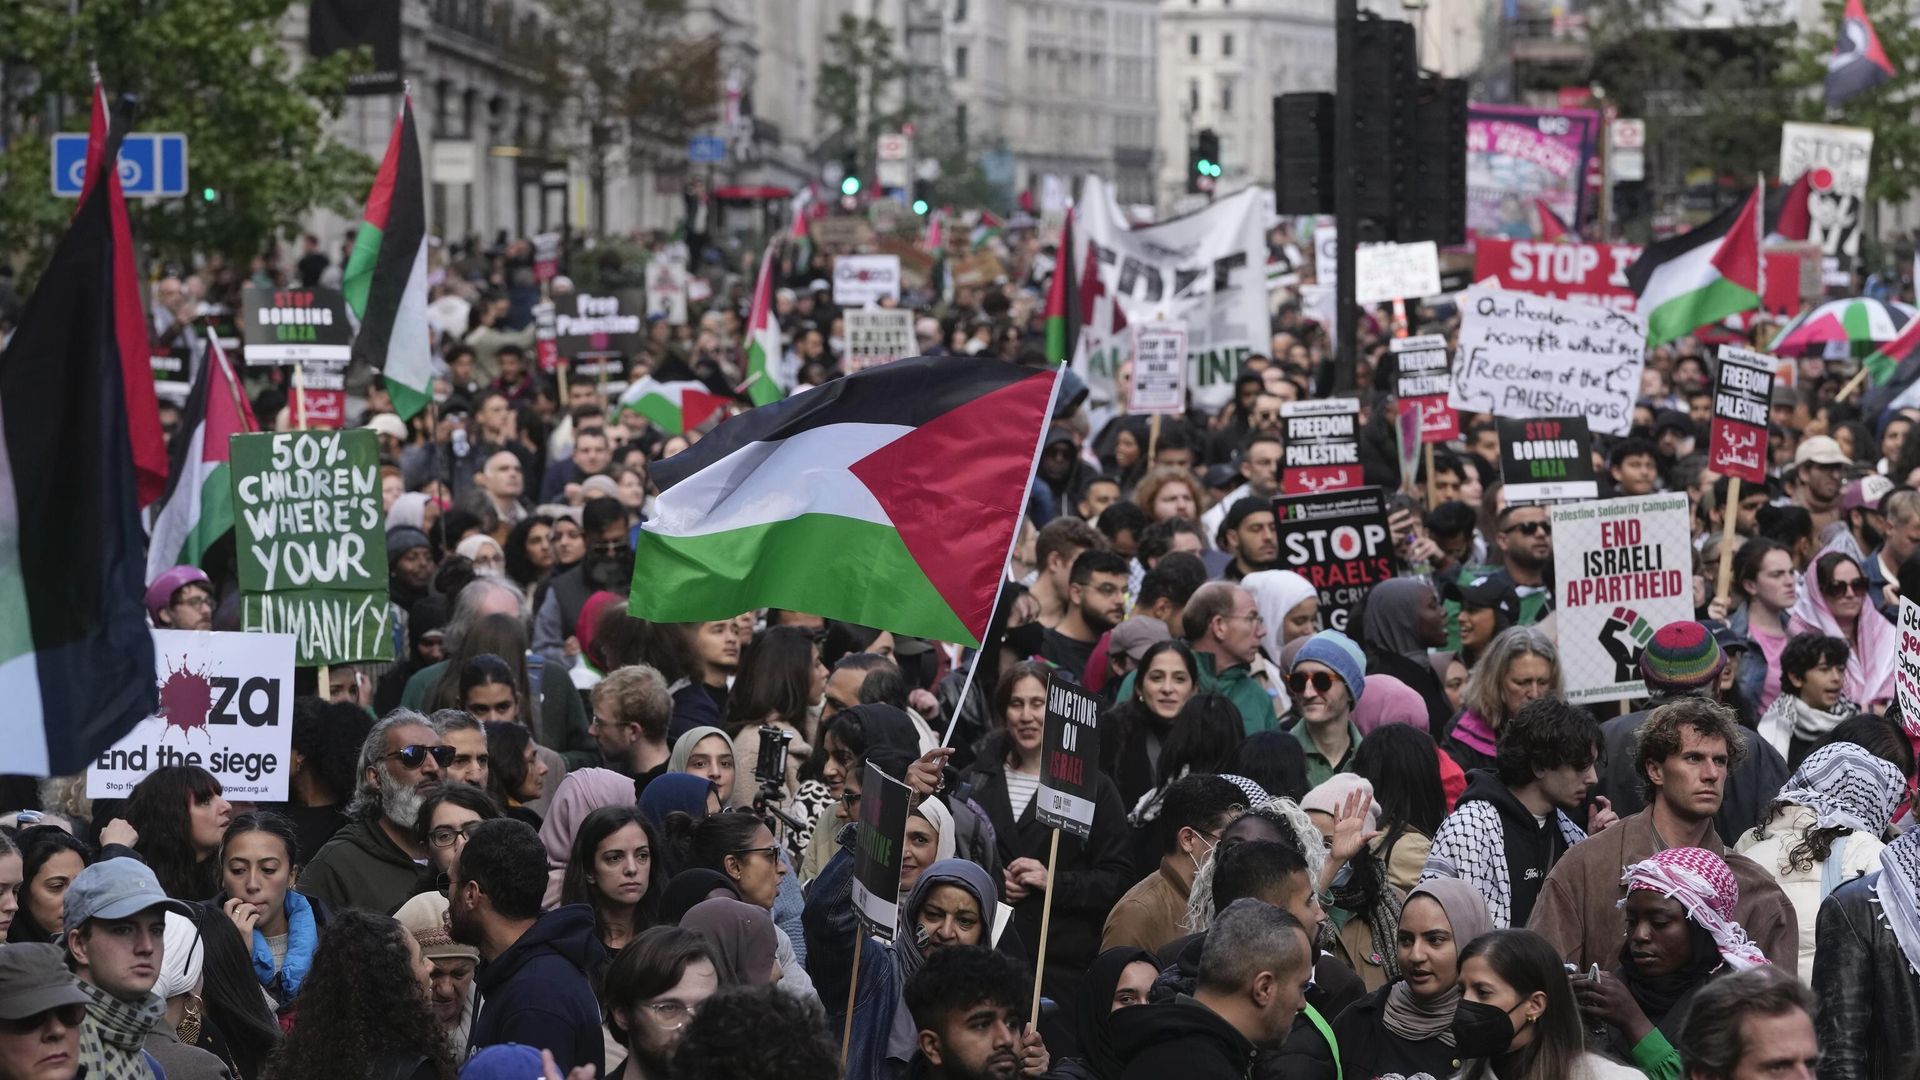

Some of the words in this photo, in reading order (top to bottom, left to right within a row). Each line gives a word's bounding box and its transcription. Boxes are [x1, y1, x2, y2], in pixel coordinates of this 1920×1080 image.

[1791, 136, 1864, 168] STOP
[1509, 242, 1598, 284] STOP
[273, 291, 315, 307] STOP
[576, 293, 619, 317] Free
[1477, 297, 1511, 318] Our
[258, 307, 333, 325] BOMBING
[556, 314, 640, 335] Palestine
[276, 324, 317, 341] GAZA
[1559, 367, 1576, 385] of
[1580, 369, 1602, 389] the
[1721, 363, 1770, 395] FREEDOM
[1716, 393, 1768, 426] PALESTINE
[1288, 415, 1354, 439] FREEDOM
[1525, 422, 1563, 440] STOP
[271, 432, 347, 472] 50%
[1286, 442, 1360, 466] PALESTINE
[1512, 439, 1579, 460] BOMBING
[238, 464, 377, 505] CHILDREN
[1531, 460, 1567, 478] GAZA
[244, 496, 379, 542] WHERE'S
[1278, 503, 1307, 521] PFB
[1553, 509, 1595, 523] Palestine
[1597, 503, 1640, 518] Solidarity
[1642, 498, 1686, 513] Campaign
[1285, 524, 1386, 565] STOP
[1601, 518, 1642, 549] END
[252, 532, 371, 591] YOUR
[1293, 557, 1392, 588] SRAEL'S
[1583, 543, 1663, 578] ISRAELI
[1567, 569, 1683, 608] APARTHEID
[243, 594, 390, 661] HUMANITY
[1049, 683, 1097, 729] SANCTIONS
[1062, 722, 1078, 752] ON
[96, 744, 148, 771] End
[156, 745, 203, 767] the
[209, 746, 278, 782] siege
[1049, 751, 1084, 786] ISRAEL
[106, 782, 124, 791] Stop
